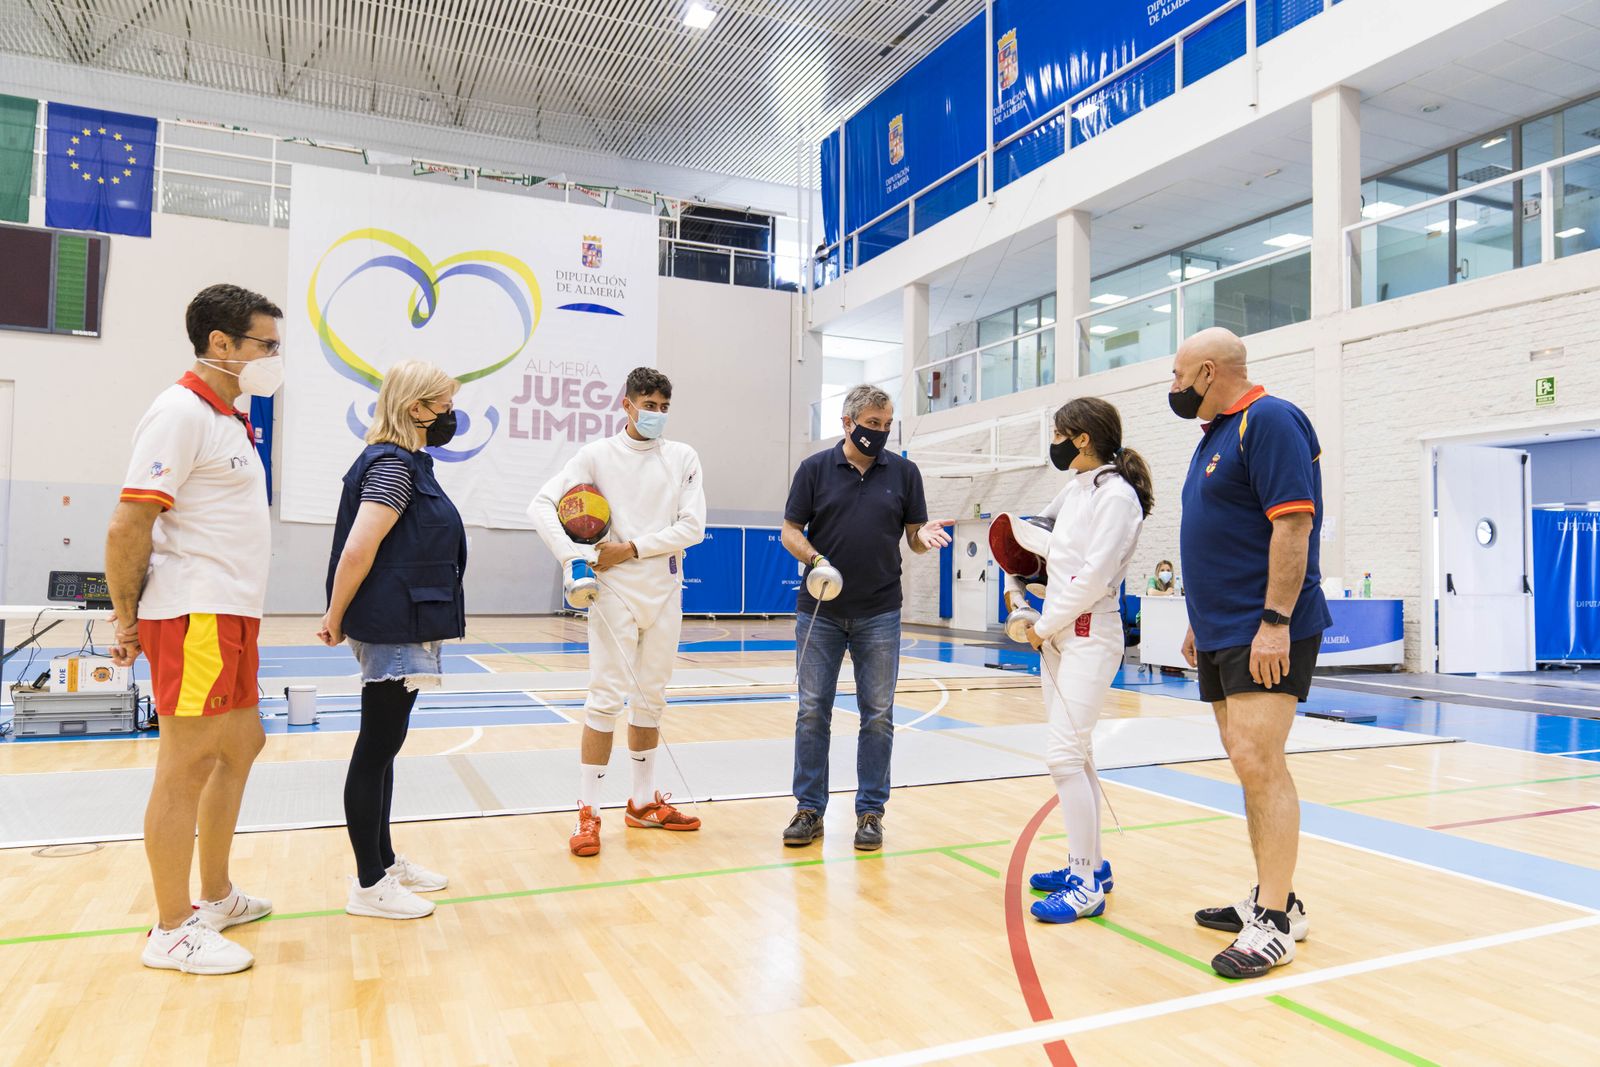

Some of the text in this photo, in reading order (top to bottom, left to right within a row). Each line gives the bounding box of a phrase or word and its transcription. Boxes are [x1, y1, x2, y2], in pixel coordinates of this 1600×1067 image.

[1148, 11, 1161, 26] DE
[555, 270, 627, 287] DIPUTACIÓN
[556, 282, 625, 299] DE ALMERÍA
[525, 358, 602, 378] ALMERÍA
[1322, 634, 1350, 644] ALMERÍA
